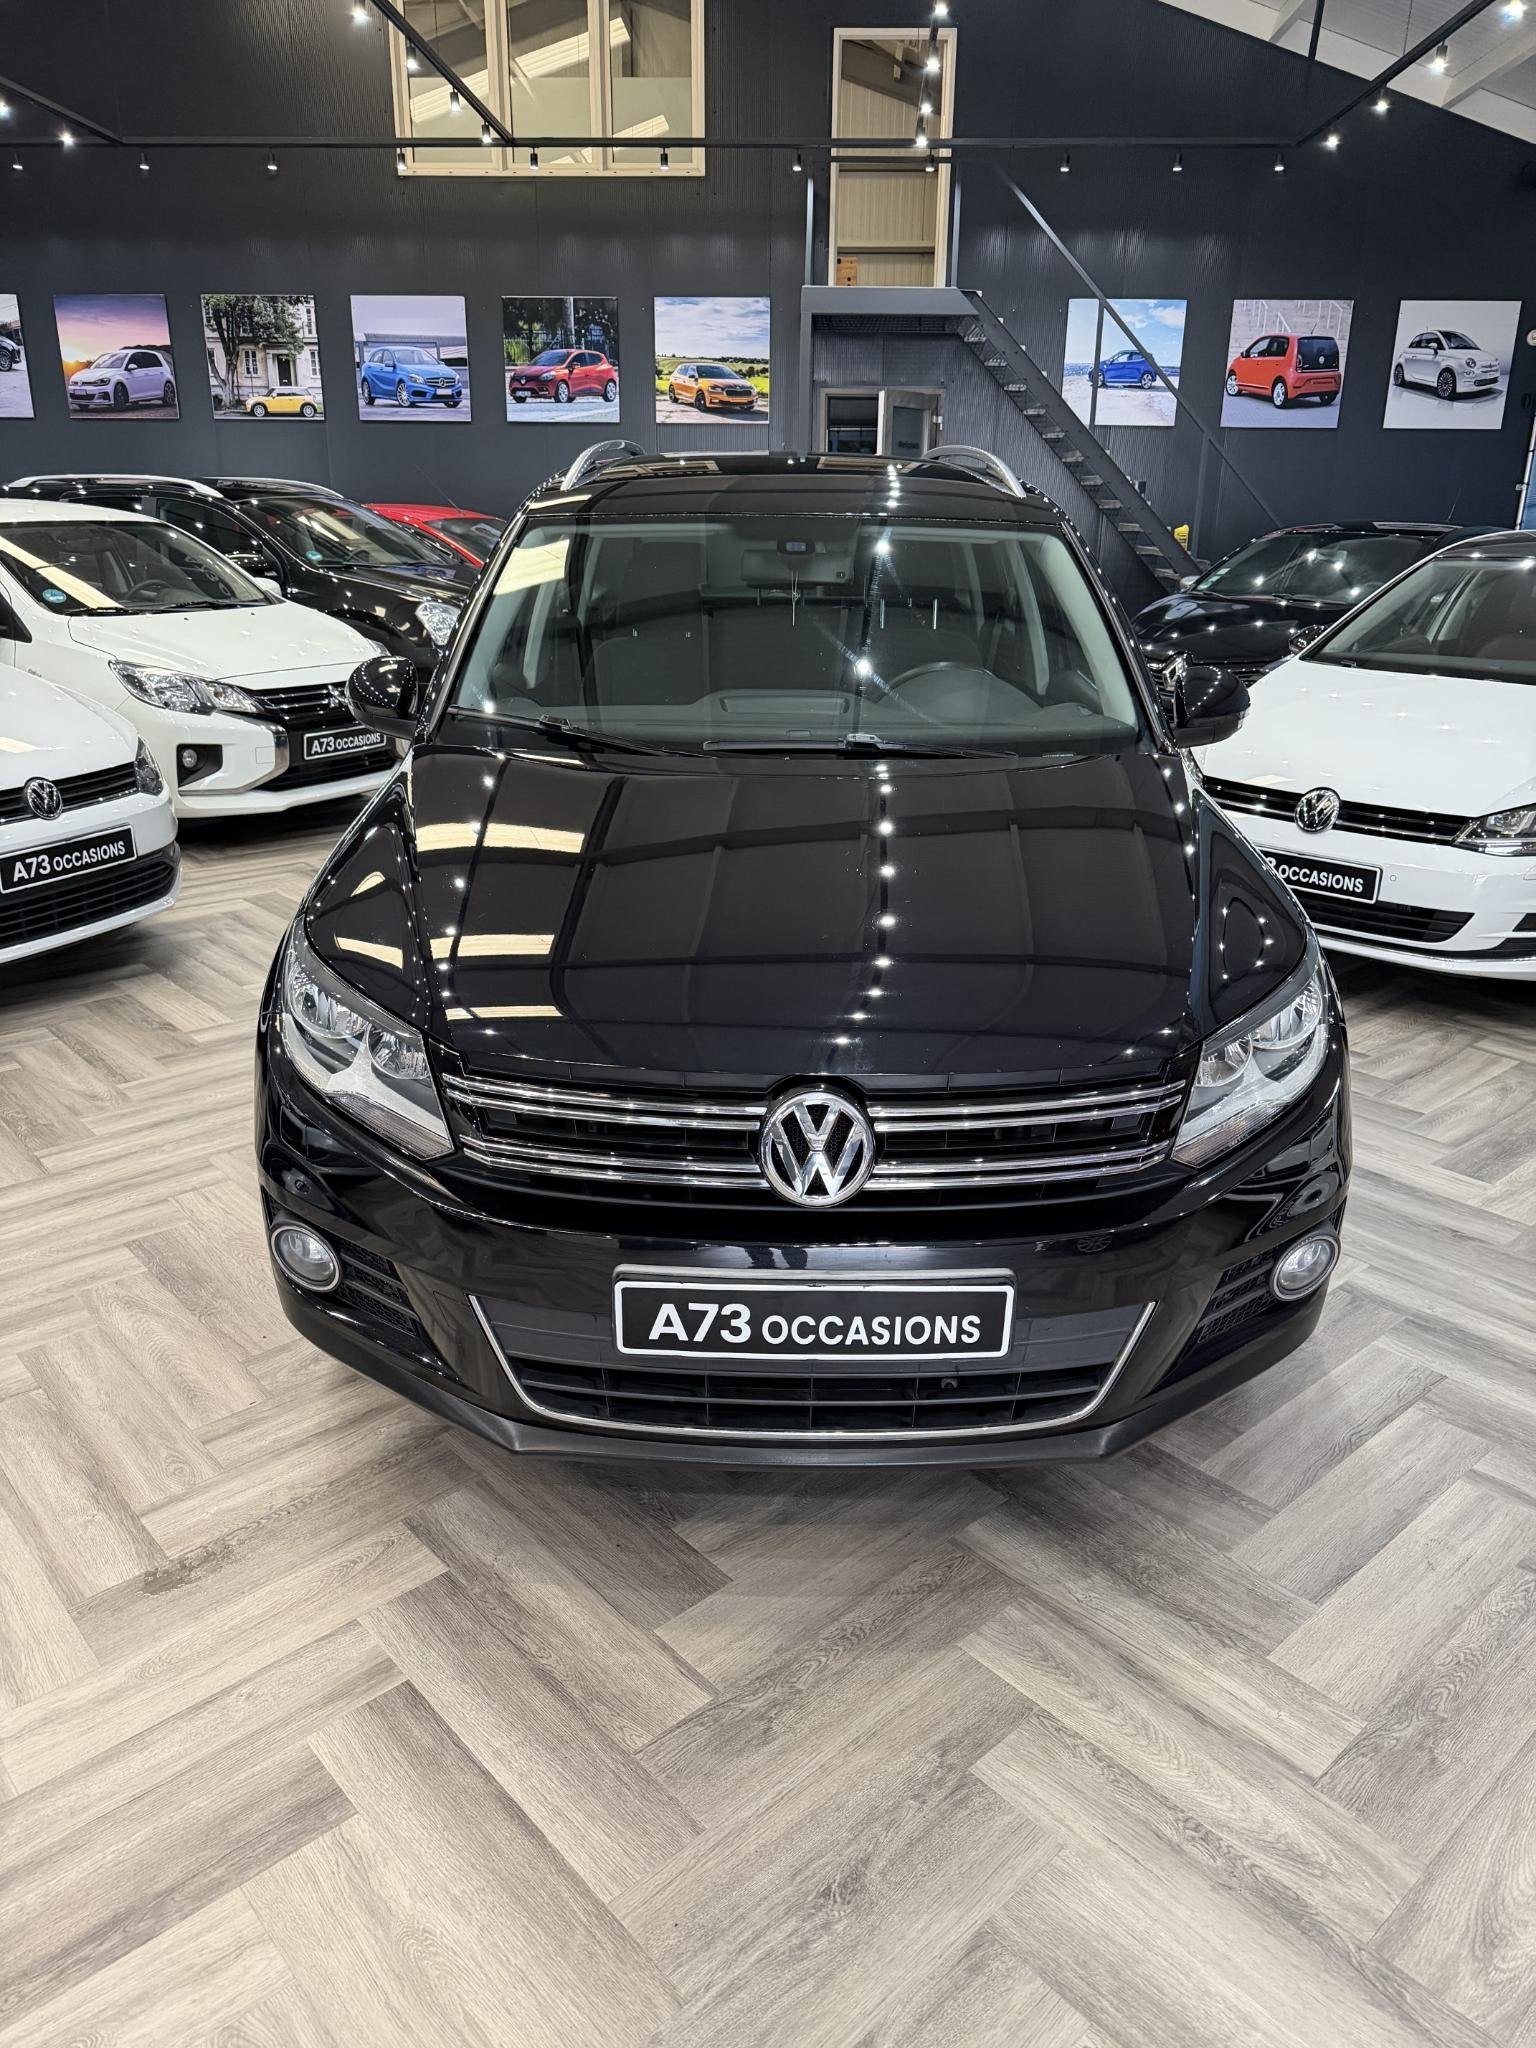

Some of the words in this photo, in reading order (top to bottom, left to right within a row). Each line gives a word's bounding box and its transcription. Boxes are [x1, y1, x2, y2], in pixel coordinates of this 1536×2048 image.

[311, 737, 335, 754] A73
[336, 733, 381, 750] OCCASIONS
[13, 854, 51, 883] A73
[53, 840, 126, 871] OCCASIONS
[1278, 865, 1364, 893] OCCASIONS
[648, 1302, 752, 1343] A73
[761, 1315, 982, 1346] OCCASIONS
